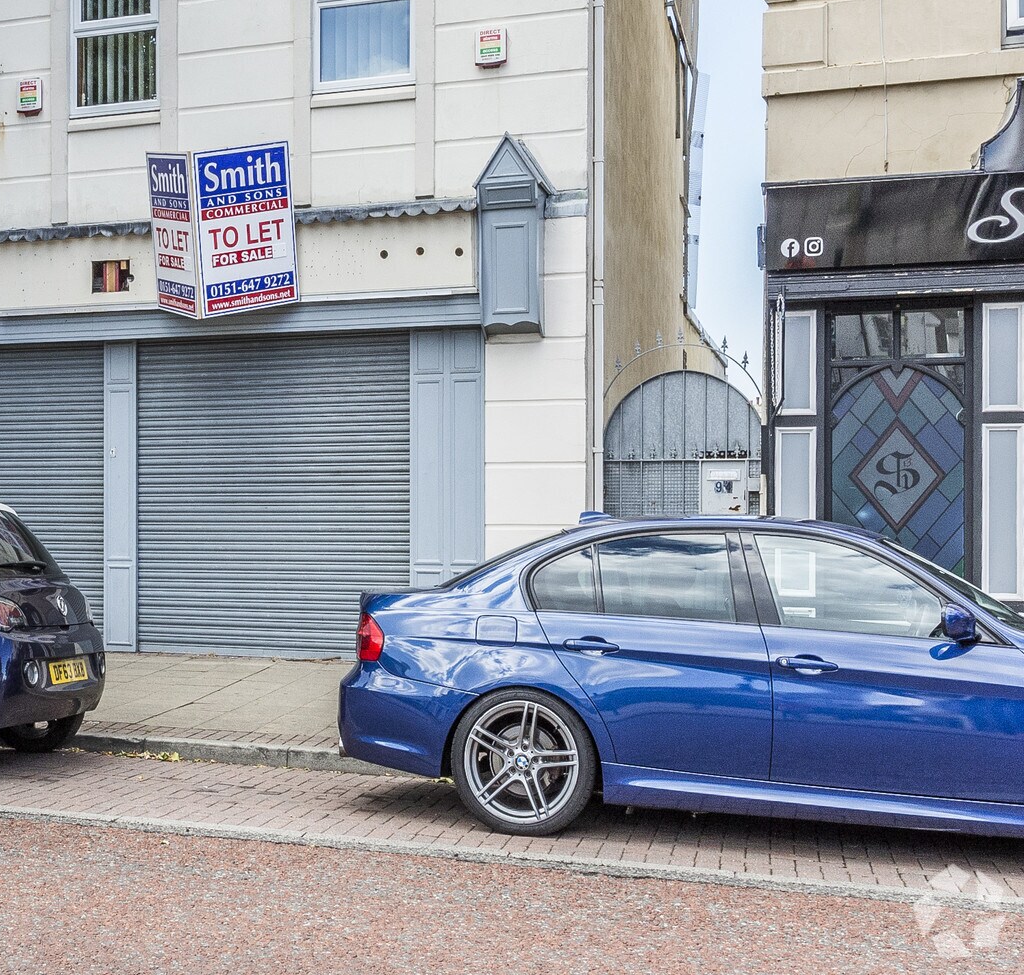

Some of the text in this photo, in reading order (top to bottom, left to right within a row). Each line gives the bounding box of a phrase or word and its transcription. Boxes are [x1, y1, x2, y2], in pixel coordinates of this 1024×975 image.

[151, 163, 186, 194] Smith
[203, 152, 282, 193] Smith
[154, 198, 187, 209] AND SONS
[206, 189, 283, 207] AND SONS
[153, 208, 189, 221] COMMERCIAL
[206, 200, 284, 220] COMMERCIAL
[156, 227, 189, 252] TO LET
[208, 219, 285, 250] TO LET
[159, 255, 185, 269] FOR SALE
[212, 246, 273, 267] FOR SALE
[159, 280, 194, 299] 0151-647 9272
[210, 273, 291, 298] 0151-647 9272
[211, 290, 291, 310] www.smithandsons.net
[53, 664, 73, 681] DF63
